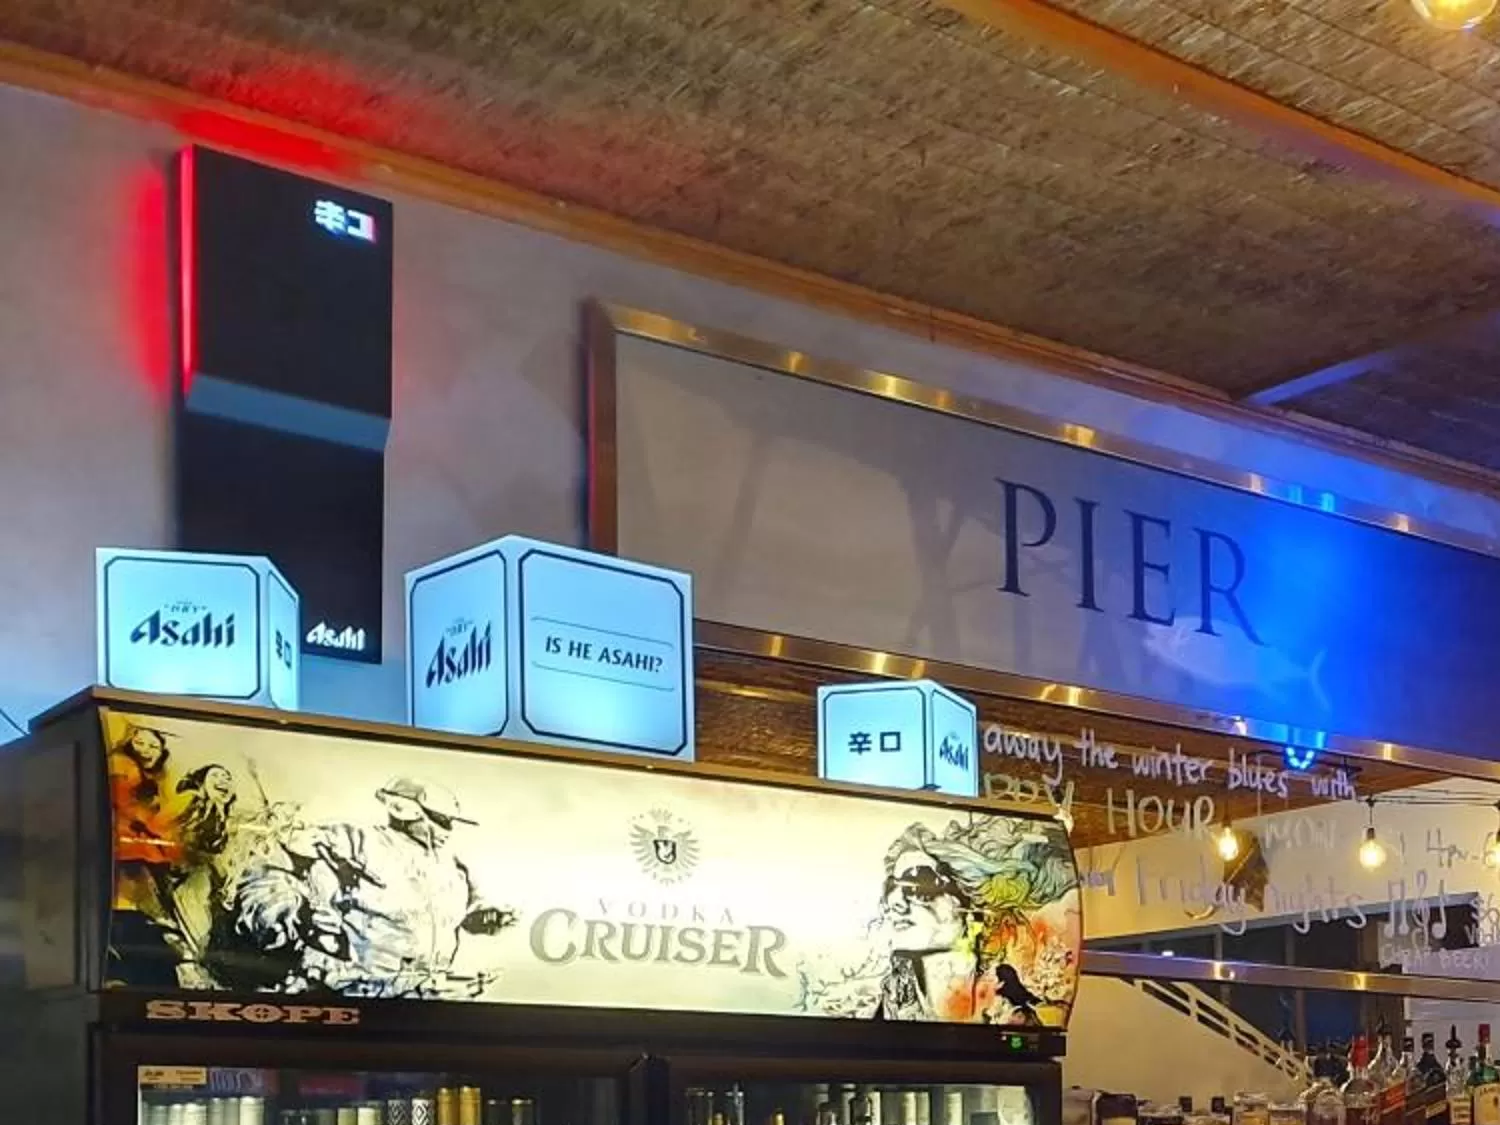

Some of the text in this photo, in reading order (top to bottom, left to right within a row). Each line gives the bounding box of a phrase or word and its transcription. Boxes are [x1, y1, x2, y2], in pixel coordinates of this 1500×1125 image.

[994, 479, 1263, 645] PIER
[130, 609, 236, 648] Asahi
[306, 621, 366, 650] Asahi
[425, 619, 492, 689] Asahi
[545, 635, 664, 673] IS HE ASAHI?
[848, 731, 902, 755] 辛口
[984, 723, 1358, 798] away the winter blues with
[1106, 786, 1216, 840] HOUR
[598, 898, 735, 925] VODKA
[529, 907, 788, 979] CRUISER
[145, 1000, 361, 1024] SKOPE
